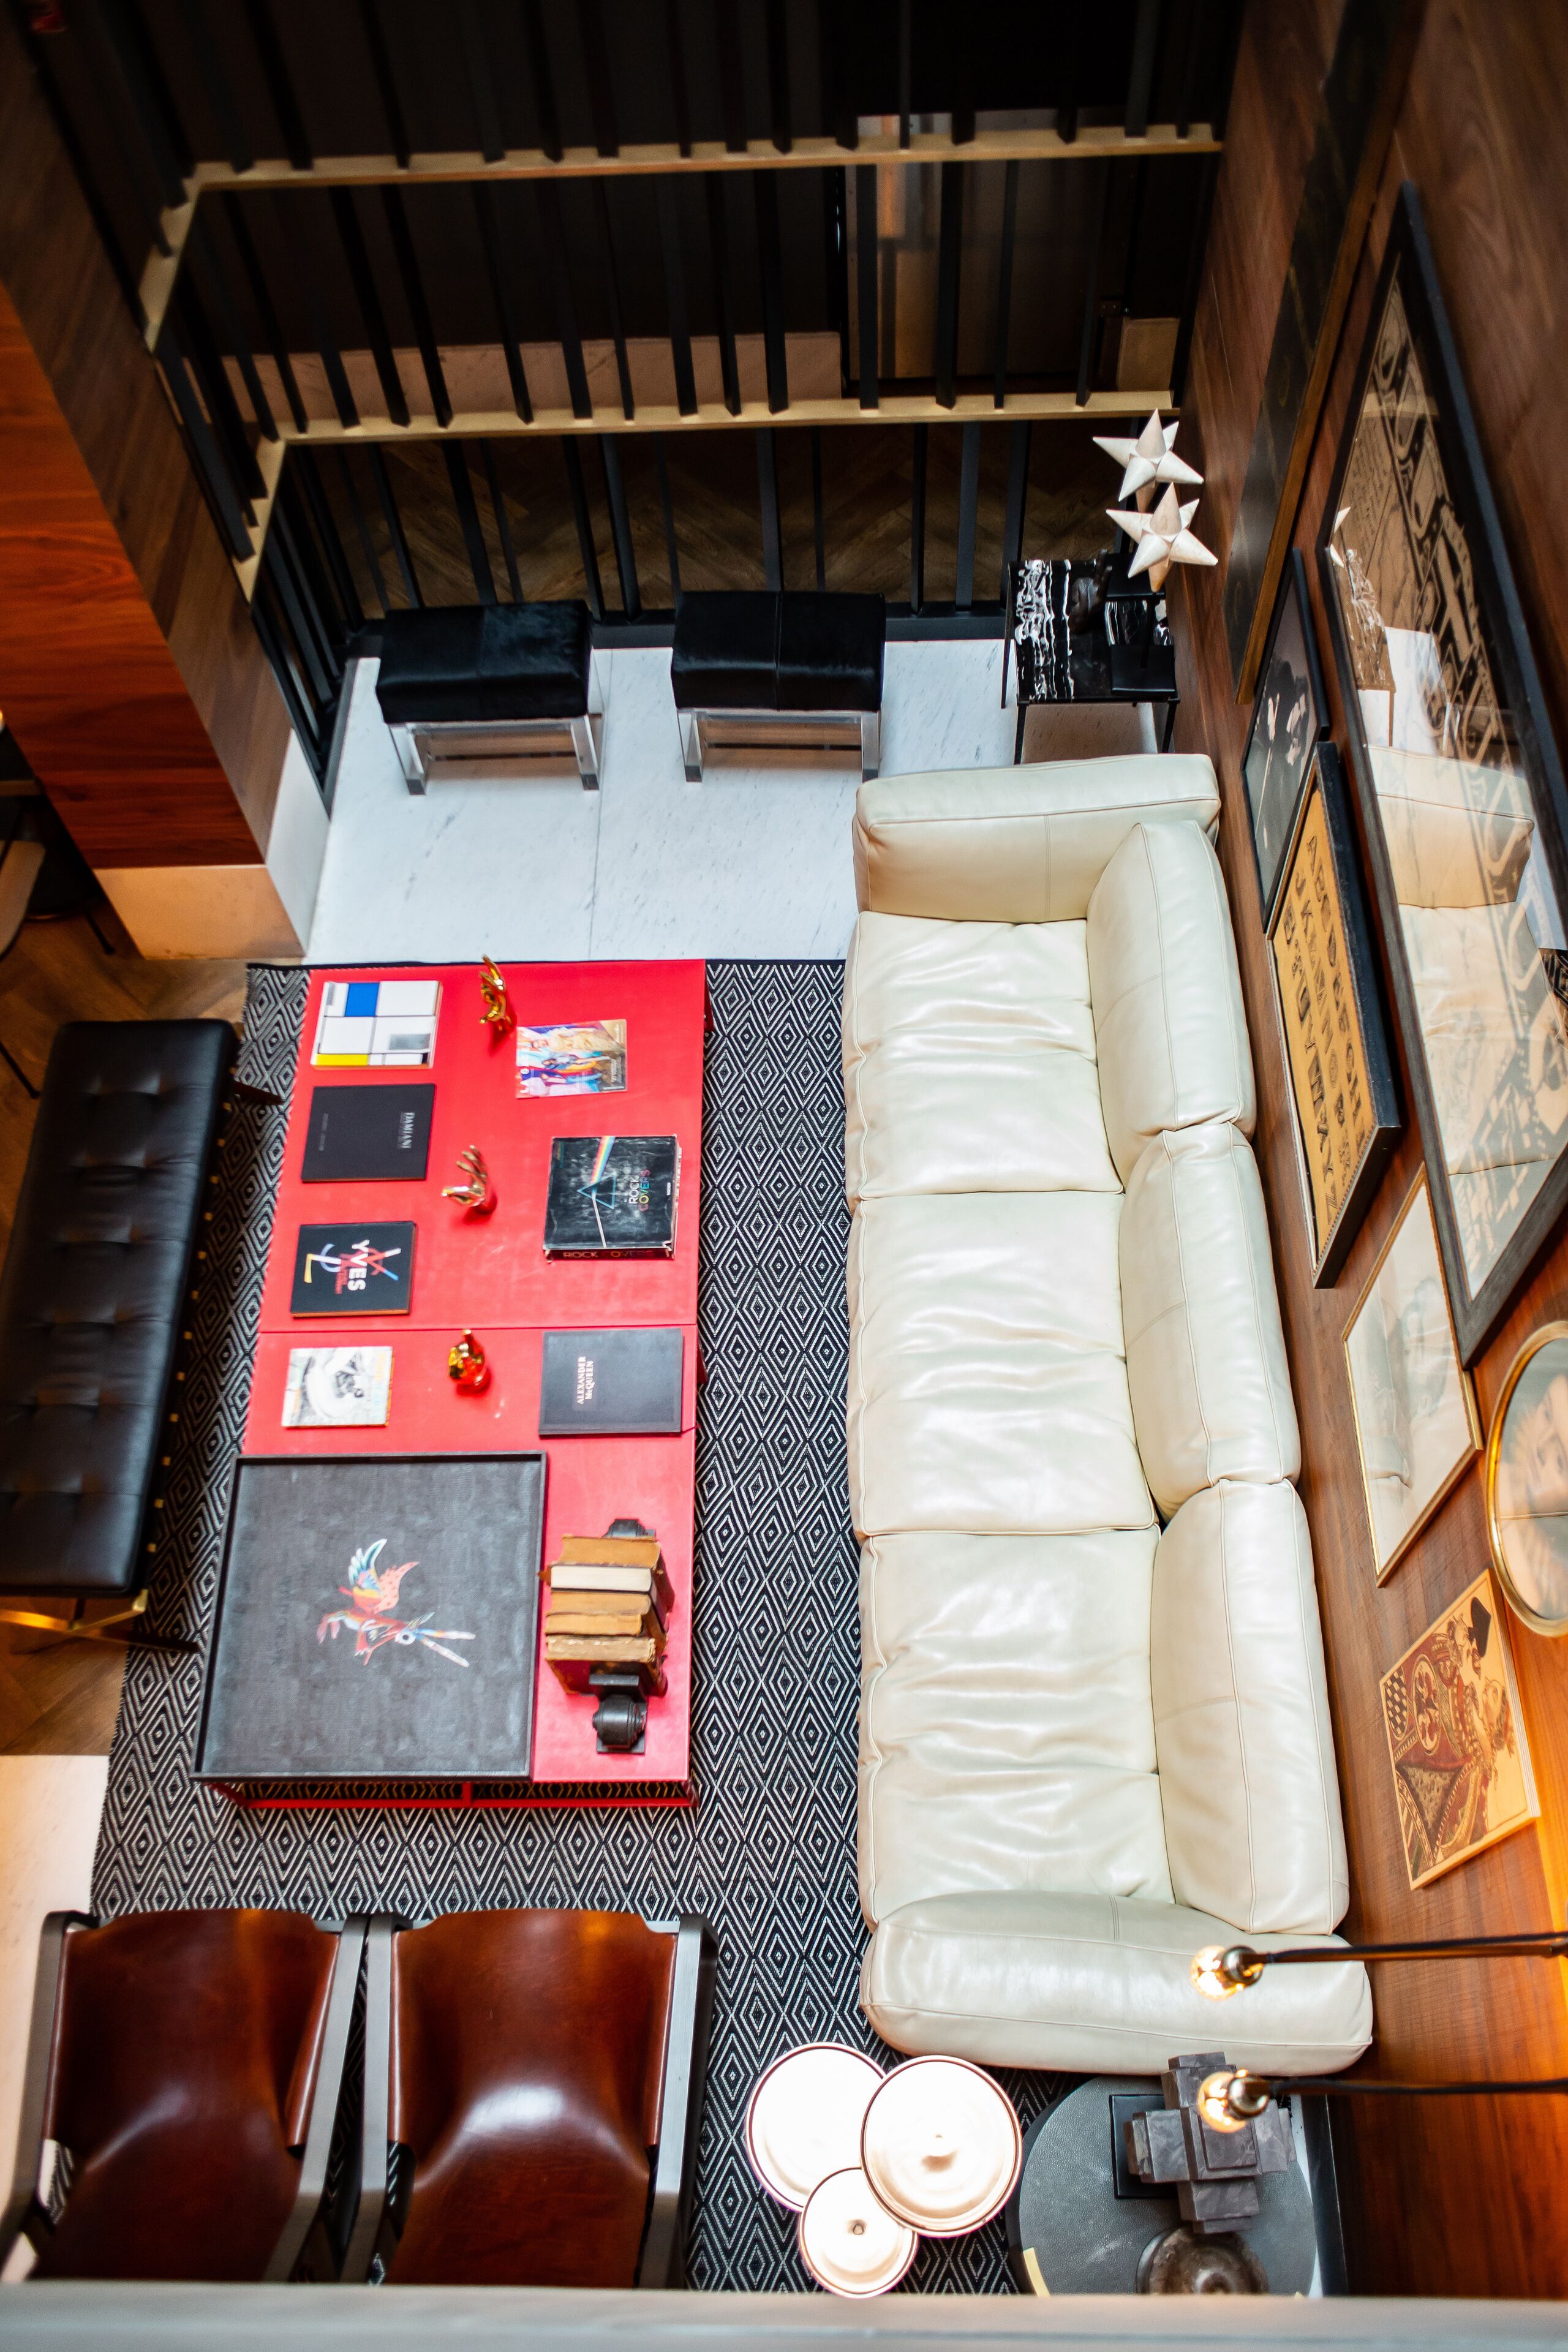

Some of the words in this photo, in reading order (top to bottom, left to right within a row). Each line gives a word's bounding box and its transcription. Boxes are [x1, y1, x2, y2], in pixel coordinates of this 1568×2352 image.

[402, 1112, 415, 1148] DAMIANI
[628, 1175, 639, 1204] ROCK
[639, 1169, 650, 1212] COVERS
[347, 1240, 370, 1291] YVES
[577, 1356, 586, 1404] ALEXANDER
[585, 1360, 595, 1400] McQUEEN
